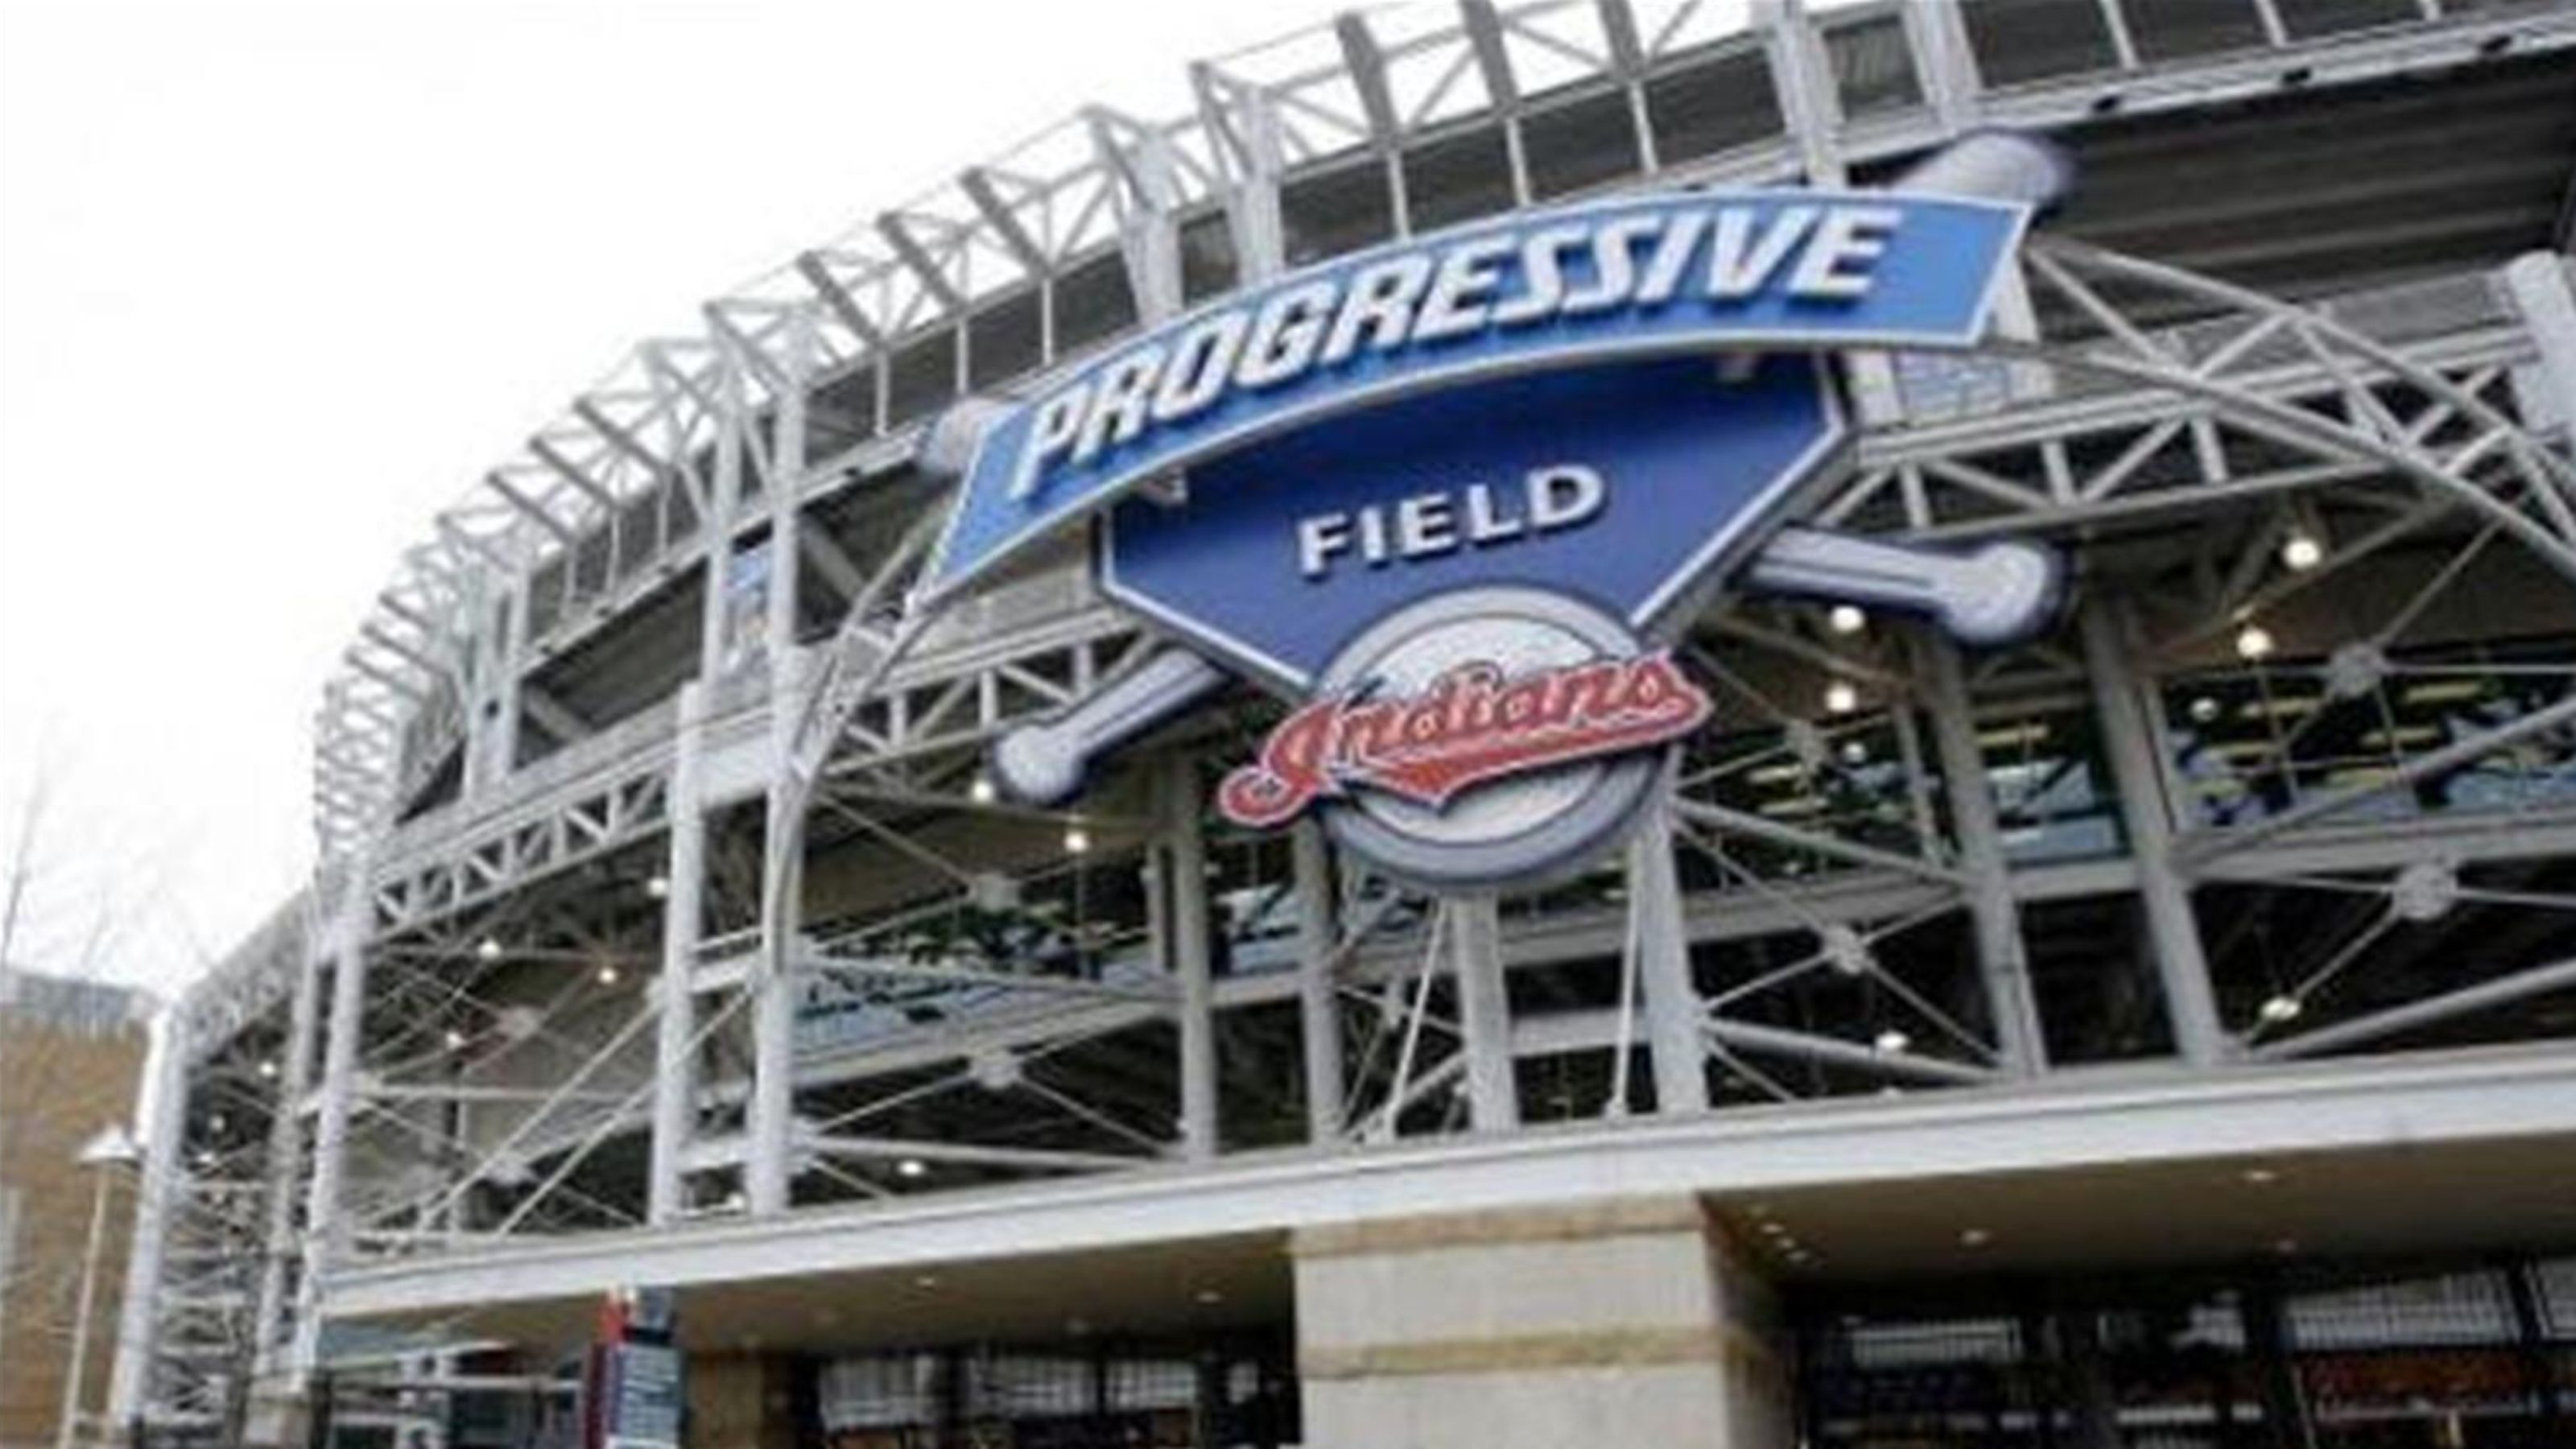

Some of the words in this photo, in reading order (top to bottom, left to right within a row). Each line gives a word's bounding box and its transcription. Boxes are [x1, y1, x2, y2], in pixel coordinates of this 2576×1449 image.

[1010, 206, 1903, 499] PROGRESSIVE
[1298, 464, 1606, 578] FIELD
[1220, 650, 1715, 828] Indians
